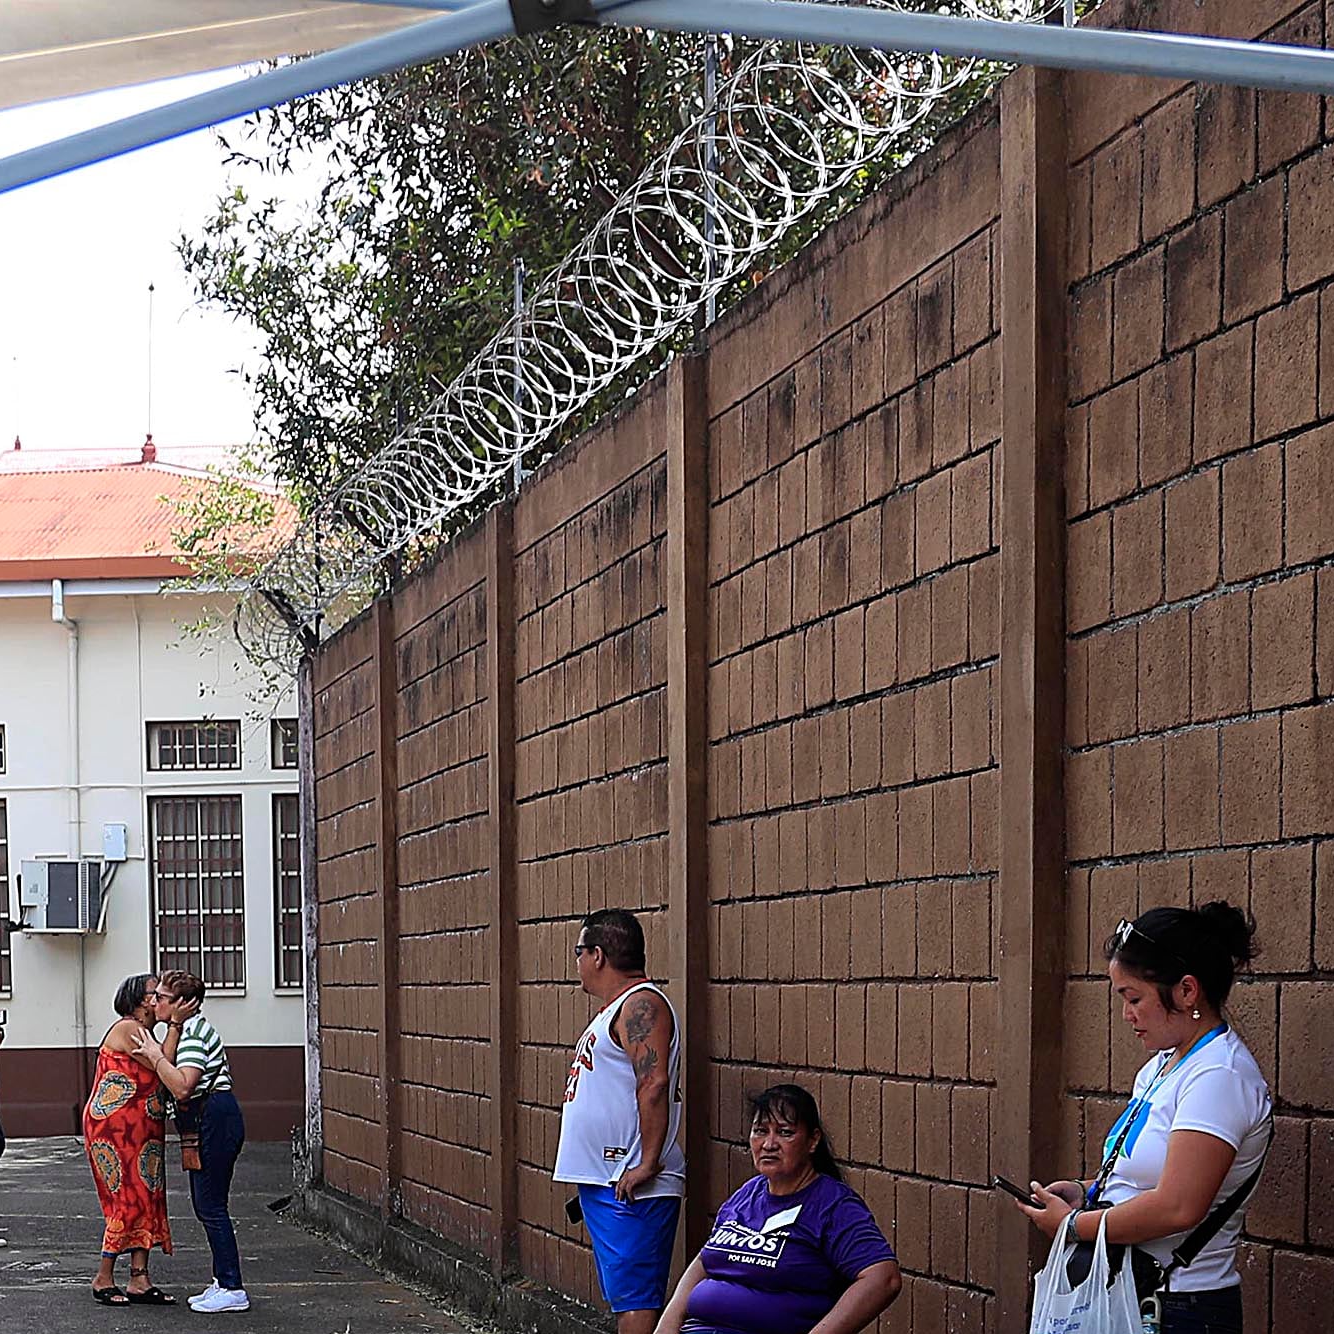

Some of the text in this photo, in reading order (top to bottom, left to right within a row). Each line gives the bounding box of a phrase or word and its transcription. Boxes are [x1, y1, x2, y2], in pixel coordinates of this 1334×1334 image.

[709, 1229, 779, 1252] JUNTOS
[728, 1254, 740, 1262] POR
[741, 1255, 755, 1264] SAN
